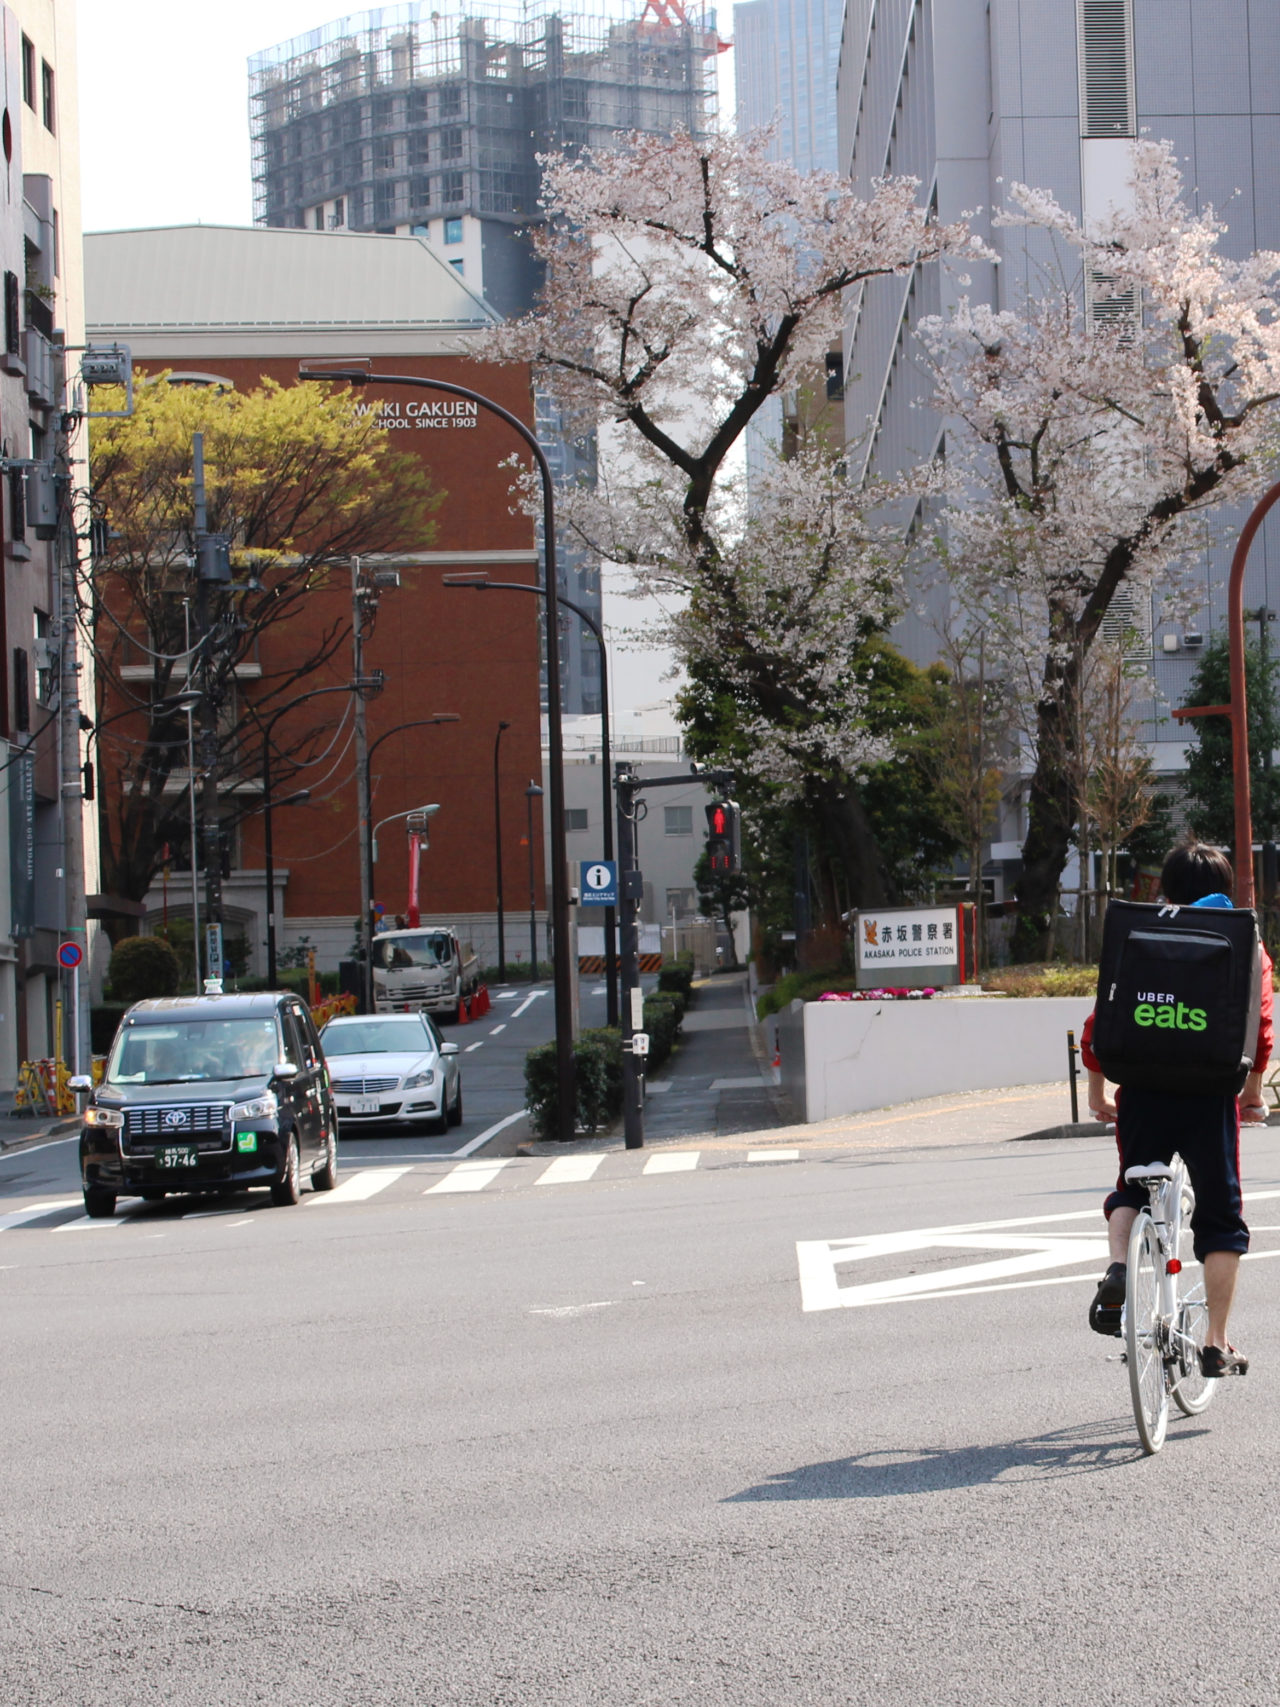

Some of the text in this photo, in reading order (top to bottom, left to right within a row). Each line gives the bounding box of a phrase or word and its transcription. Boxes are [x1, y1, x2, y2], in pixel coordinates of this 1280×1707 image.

[405, 401, 478, 417] GAKUEN
[415, 417, 449, 429] SINCE
[451, 417, 477, 428] 1903
[881, 922, 953, 943] 赤坂警察署
[864, 945, 954, 959] AKASAKA POLICE STATION
[1137, 992, 1175, 1004] UBER
[1134, 1002, 1207, 1031] eats
